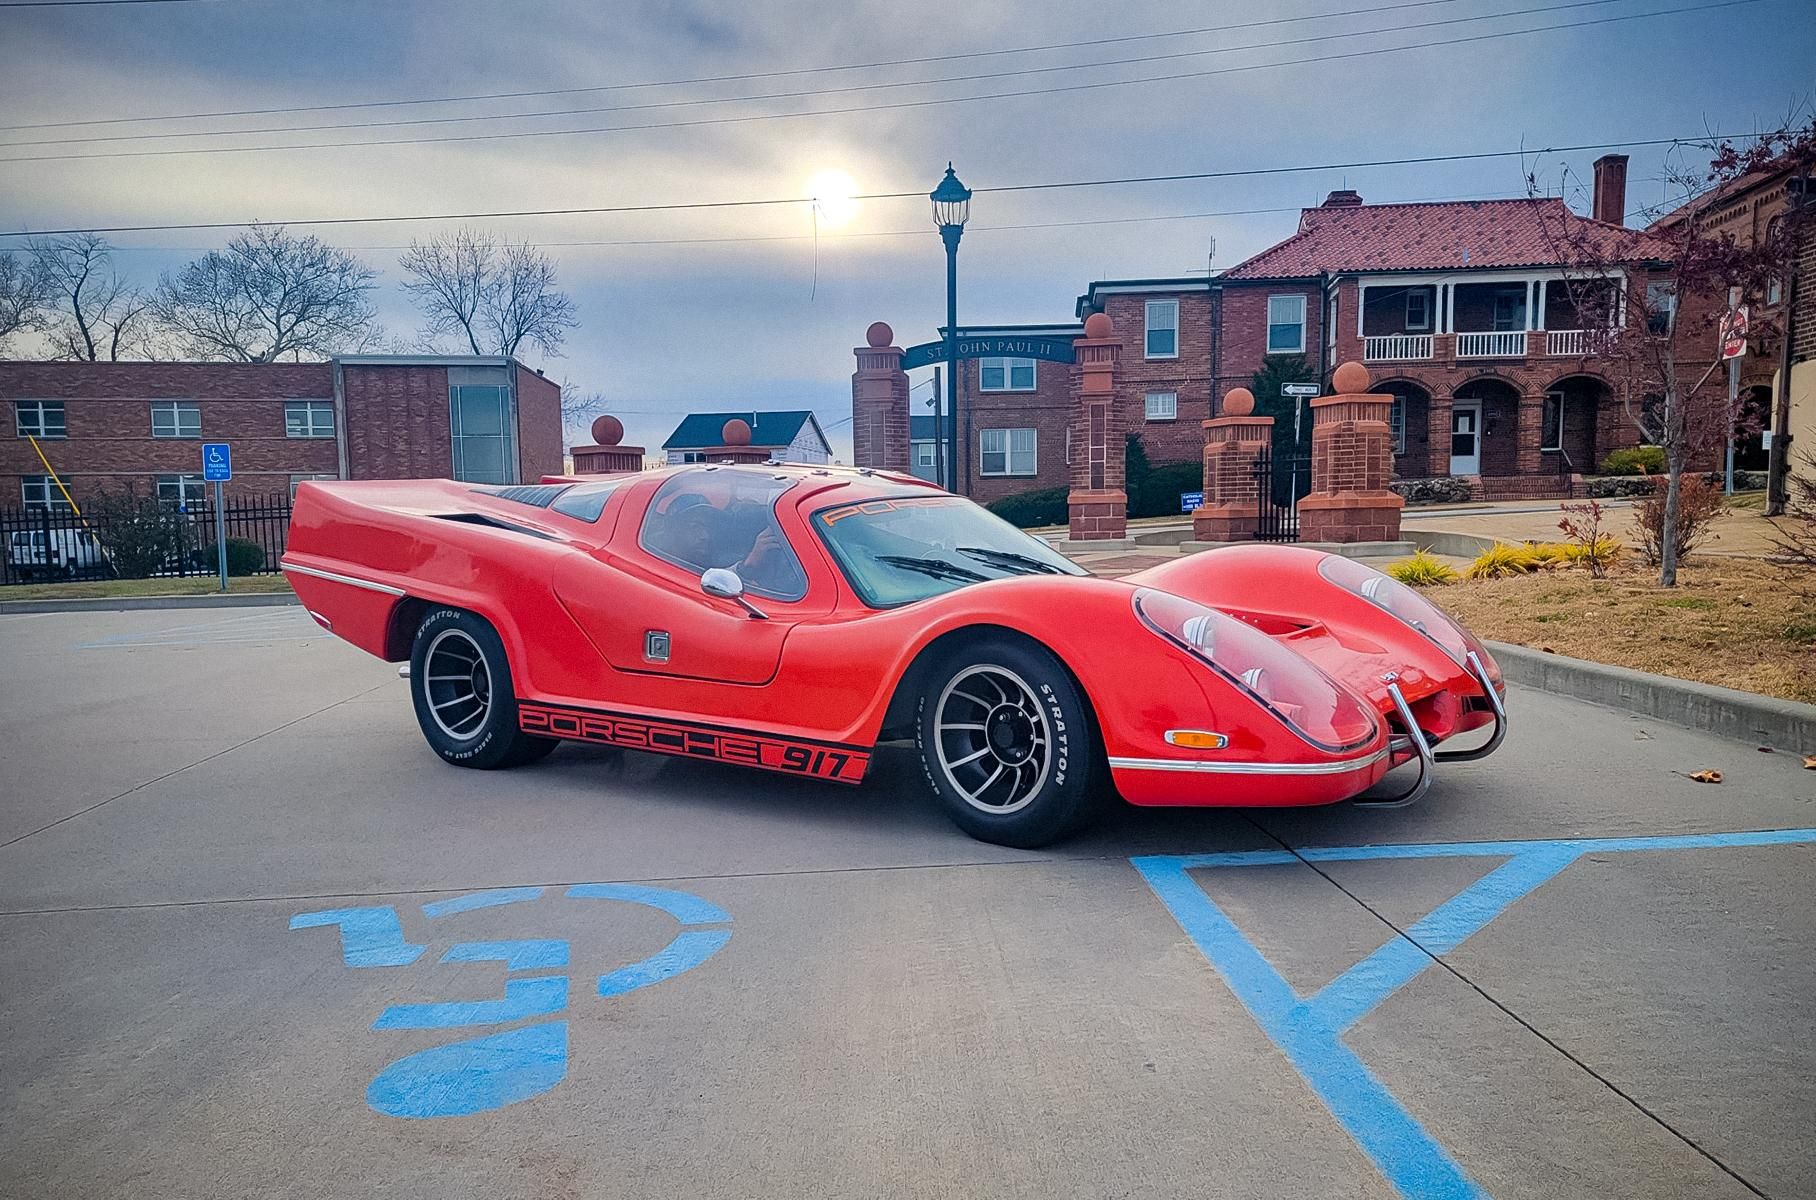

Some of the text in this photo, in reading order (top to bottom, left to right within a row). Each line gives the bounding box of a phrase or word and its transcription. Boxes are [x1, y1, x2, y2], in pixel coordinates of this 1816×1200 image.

[959, 341, 991, 353] OHN
[998, 341, 1034, 353] PAUL
[1039, 343, 1051, 354] II
[417, 610, 461, 640] STRATTON
[518, 710, 850, 779] PORSCHE 917
[1041, 683, 1069, 787] STRATTON
